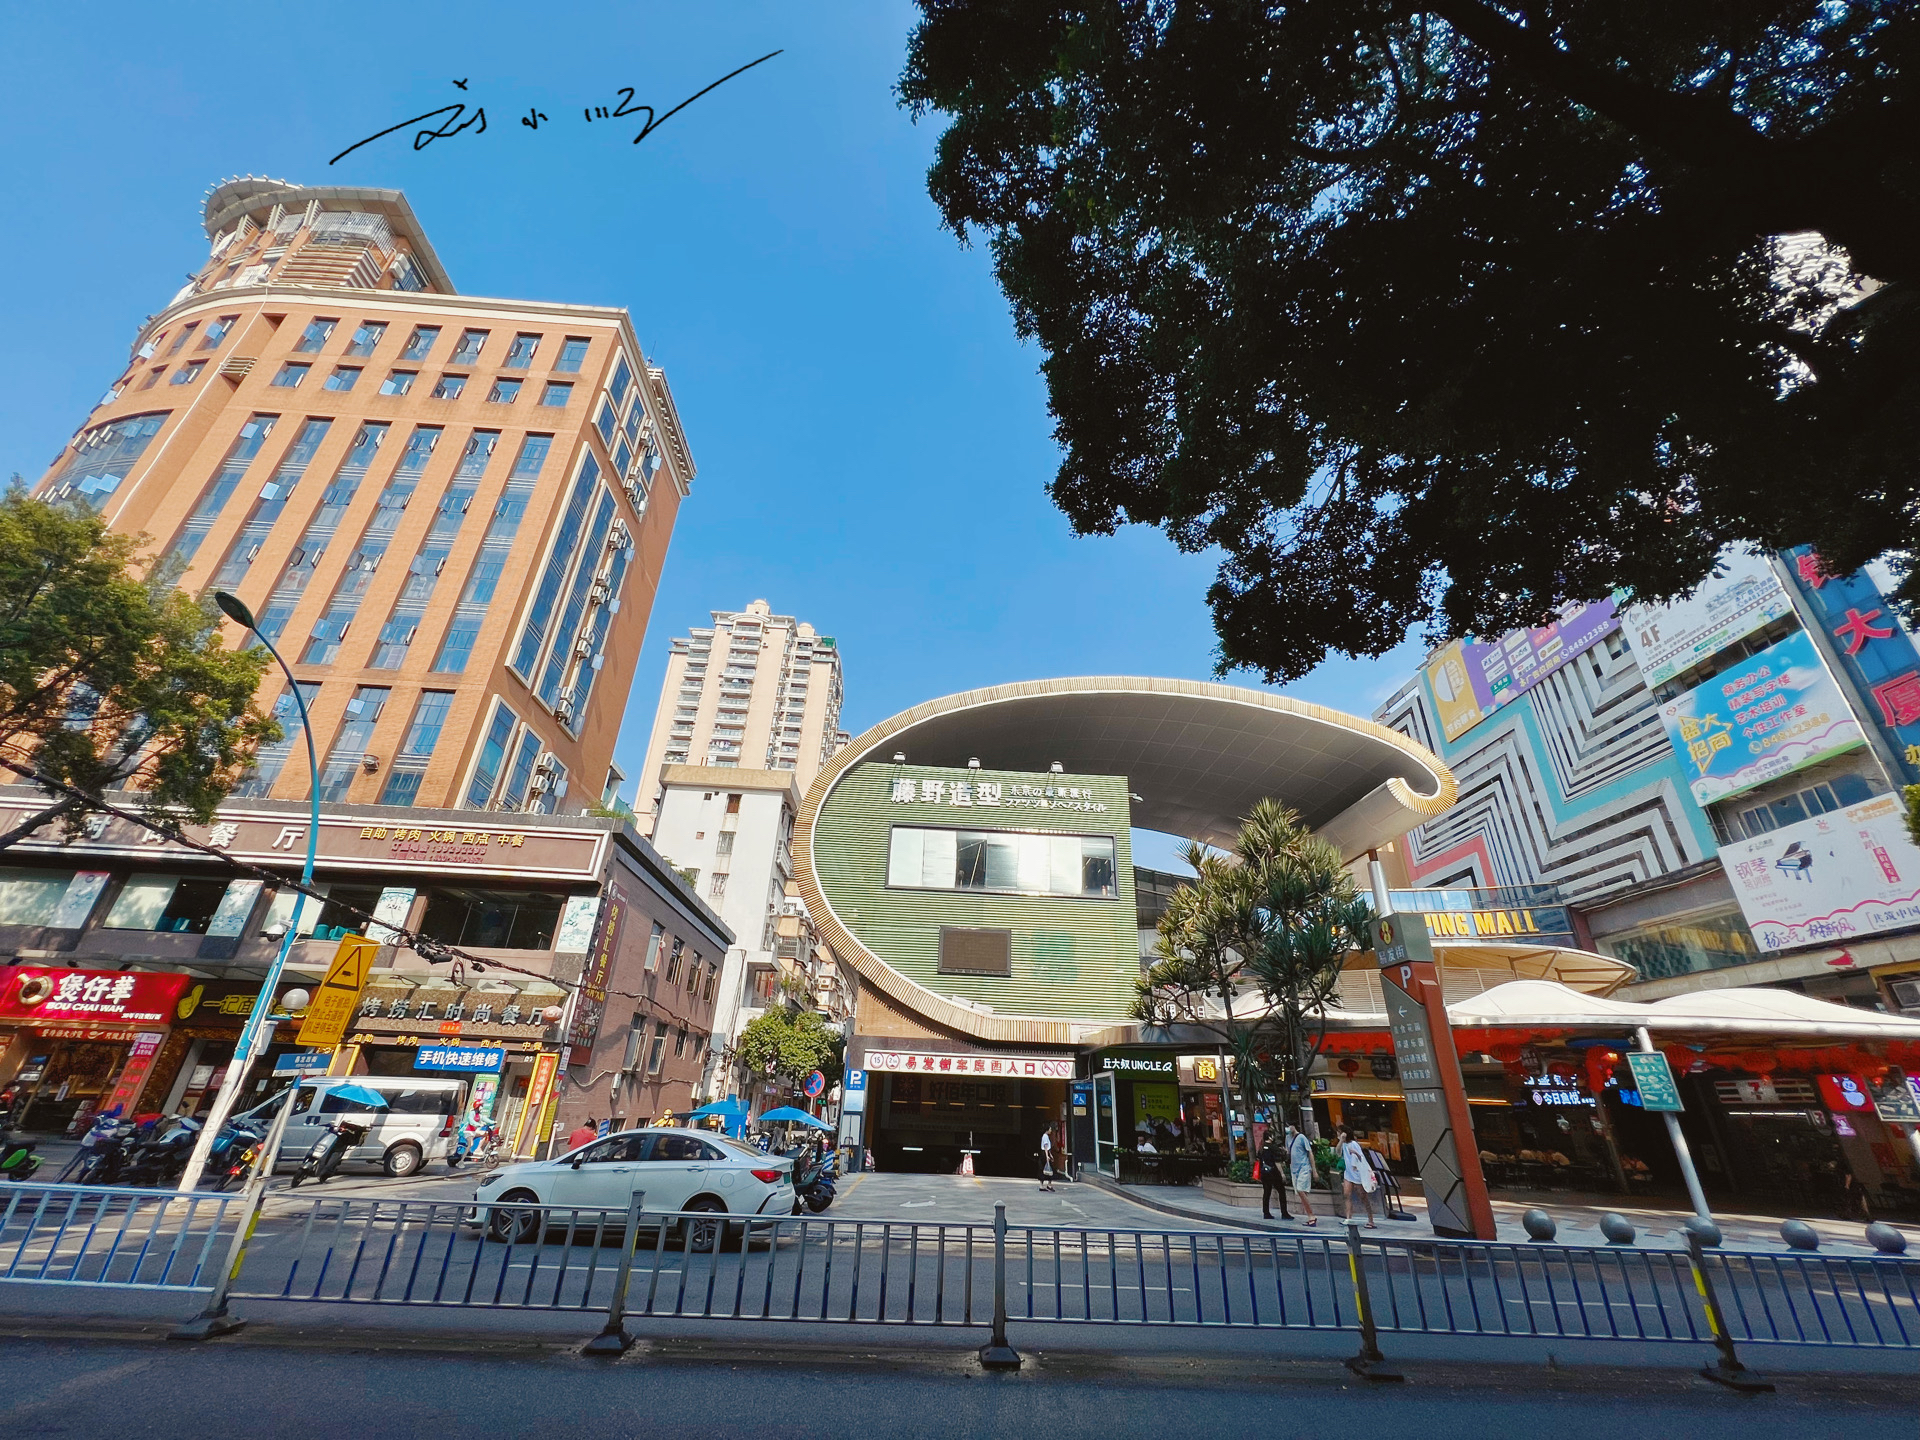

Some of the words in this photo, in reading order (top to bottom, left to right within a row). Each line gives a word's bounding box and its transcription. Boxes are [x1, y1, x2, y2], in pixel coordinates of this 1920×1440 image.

[1568, 621, 1610, 653] 84812388
[1640, 623, 1661, 649] 4F
[1519, 656, 1562, 687] 本广告位招商
[1722, 665, 1771, 697] 商务办公
[1728, 674, 1792, 711] 精装写字楼
[1735, 694, 1787, 725] 艺术培训
[1743, 704, 1808, 738] 个性工作室
[1680, 713, 1721, 742] 盛大
[1762, 712, 1830, 748] 84812388
[1688, 731, 1732, 760] 招商
[891, 778, 1001, 807] 藤野造型
[360, 827, 388, 840] 自助
[392, 828, 422, 842] 烤肉
[427, 830, 456, 844] 火锅
[461, 832, 490, 846] 西点
[497, 834, 525, 848] 中餐
[1734, 857, 1769, 880] 钢琴
[1743, 872, 1774, 890] 培训班
[1474, 909, 1540, 935] MALL
[1378, 945, 1404, 964] 易发街
[53, 973, 136, 1004] 煲仔華
[1400, 966, 1412, 988] P
[45, 1001, 72, 1011] BOU
[72, 1002, 99, 1012] CHAI
[99, 1004, 126, 1013] WAH
[358, 996, 545, 1026] 烤捞汇时尚餐厅
[353, 1033, 375, 1043] 自助
[396, 1035, 418, 1046] 烤肉
[438, 1037, 461, 1047] 火锅
[522, 1041, 543, 1051] 中餐
[418, 1050, 500, 1068] 手机快速维修
[1103, 1057, 1131, 1070] 丘大叔
[1197, 1060, 1217, 1080] 商
[850, 1070, 863, 1085] P
